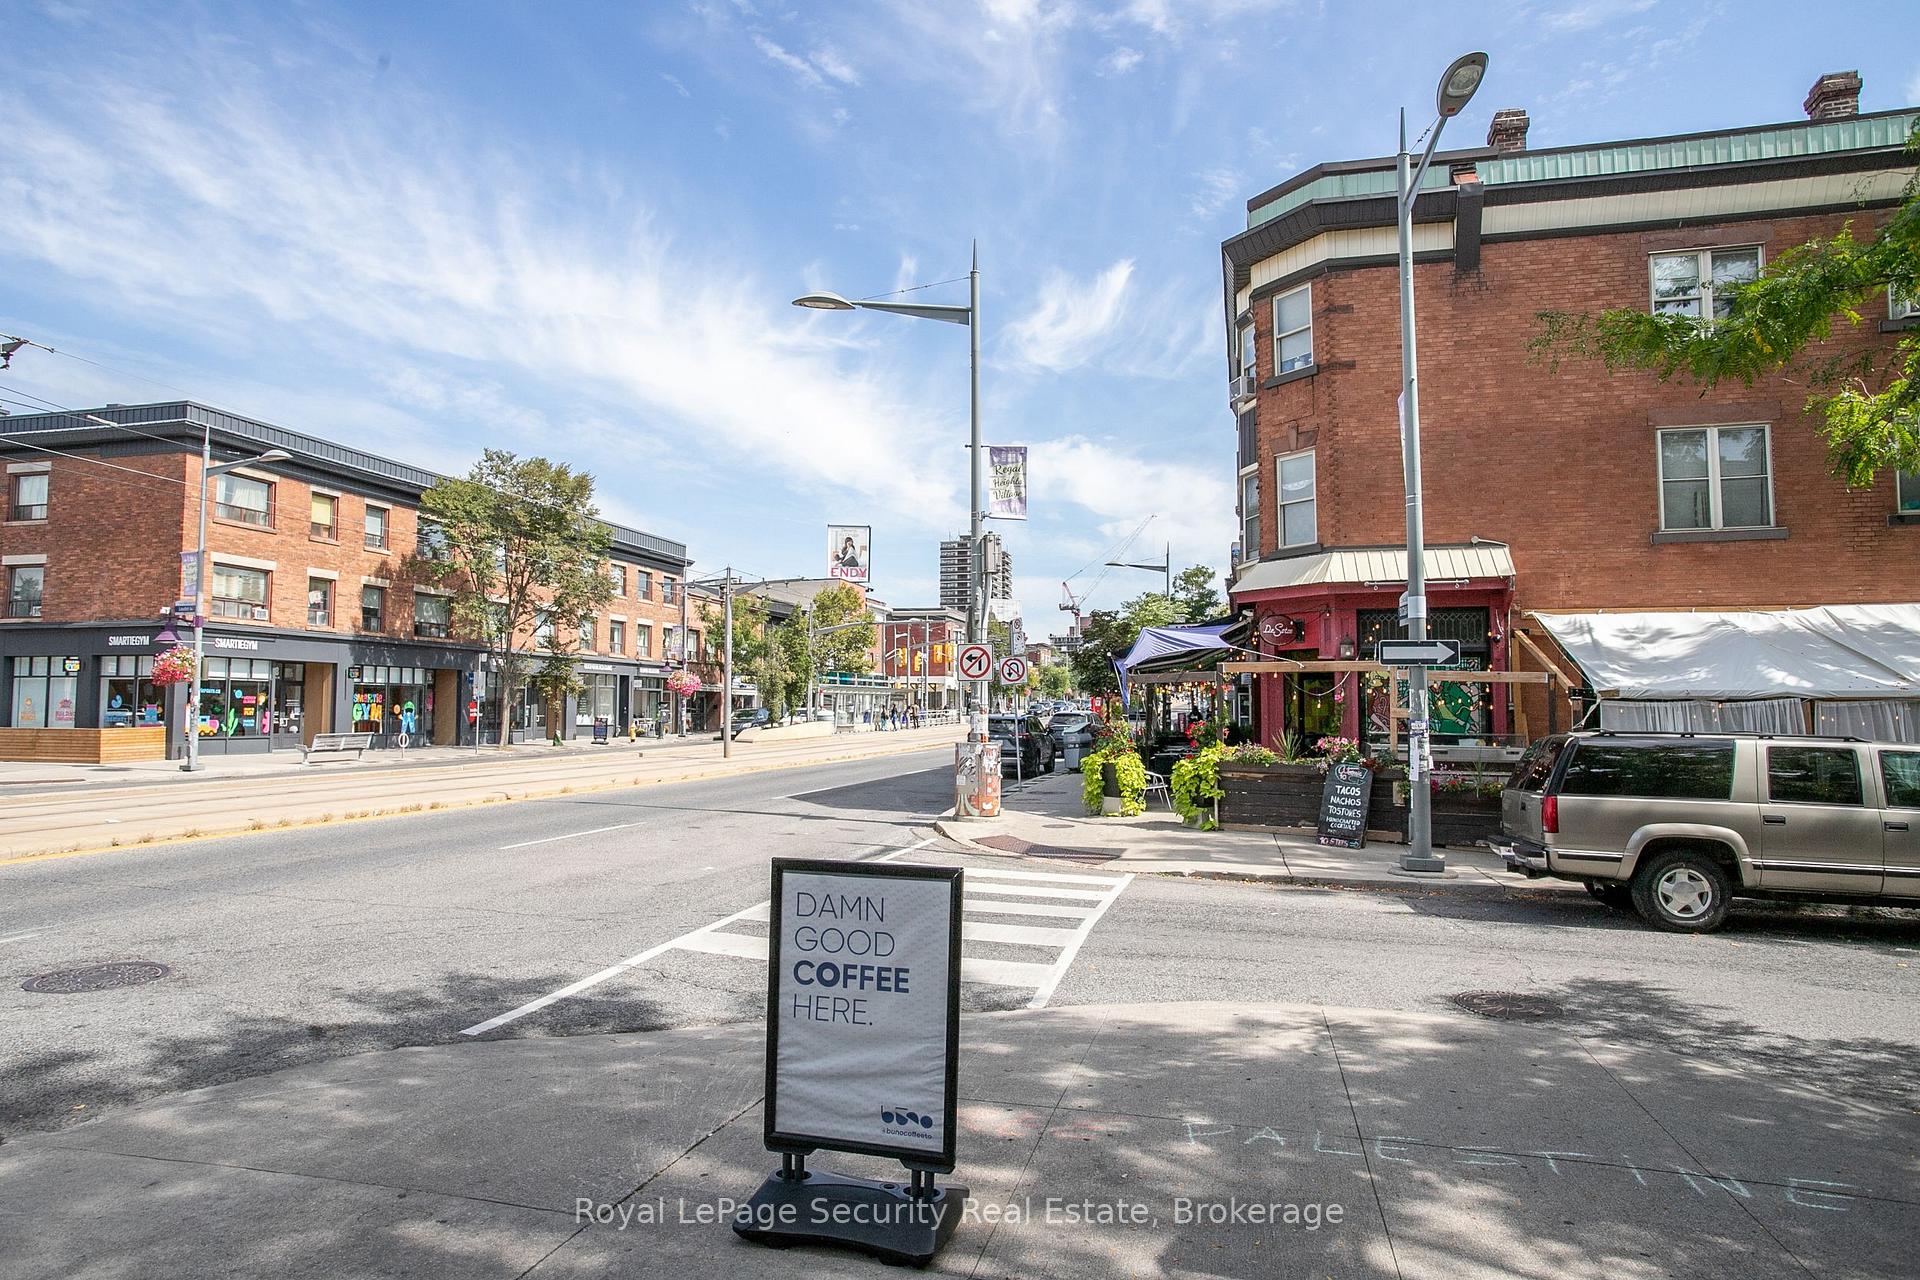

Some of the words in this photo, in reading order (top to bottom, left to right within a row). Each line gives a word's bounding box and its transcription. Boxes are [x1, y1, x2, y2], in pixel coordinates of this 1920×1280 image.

[995, 463, 1023, 475] Regal
[993, 475, 1022, 488] Heights
[993, 488, 1022, 500] Village
[831, 567, 867, 578] ENDY
[352, 703, 382, 721] GYM
[1335, 785, 1361, 796] TACOS
[1330, 795, 1361, 806] NACHOS
[796, 892, 885, 922] DAMN
[794, 926, 895, 957] GOOD
[793, 960, 910, 994] COFFEE
[793, 993, 873, 1026] HERE.
